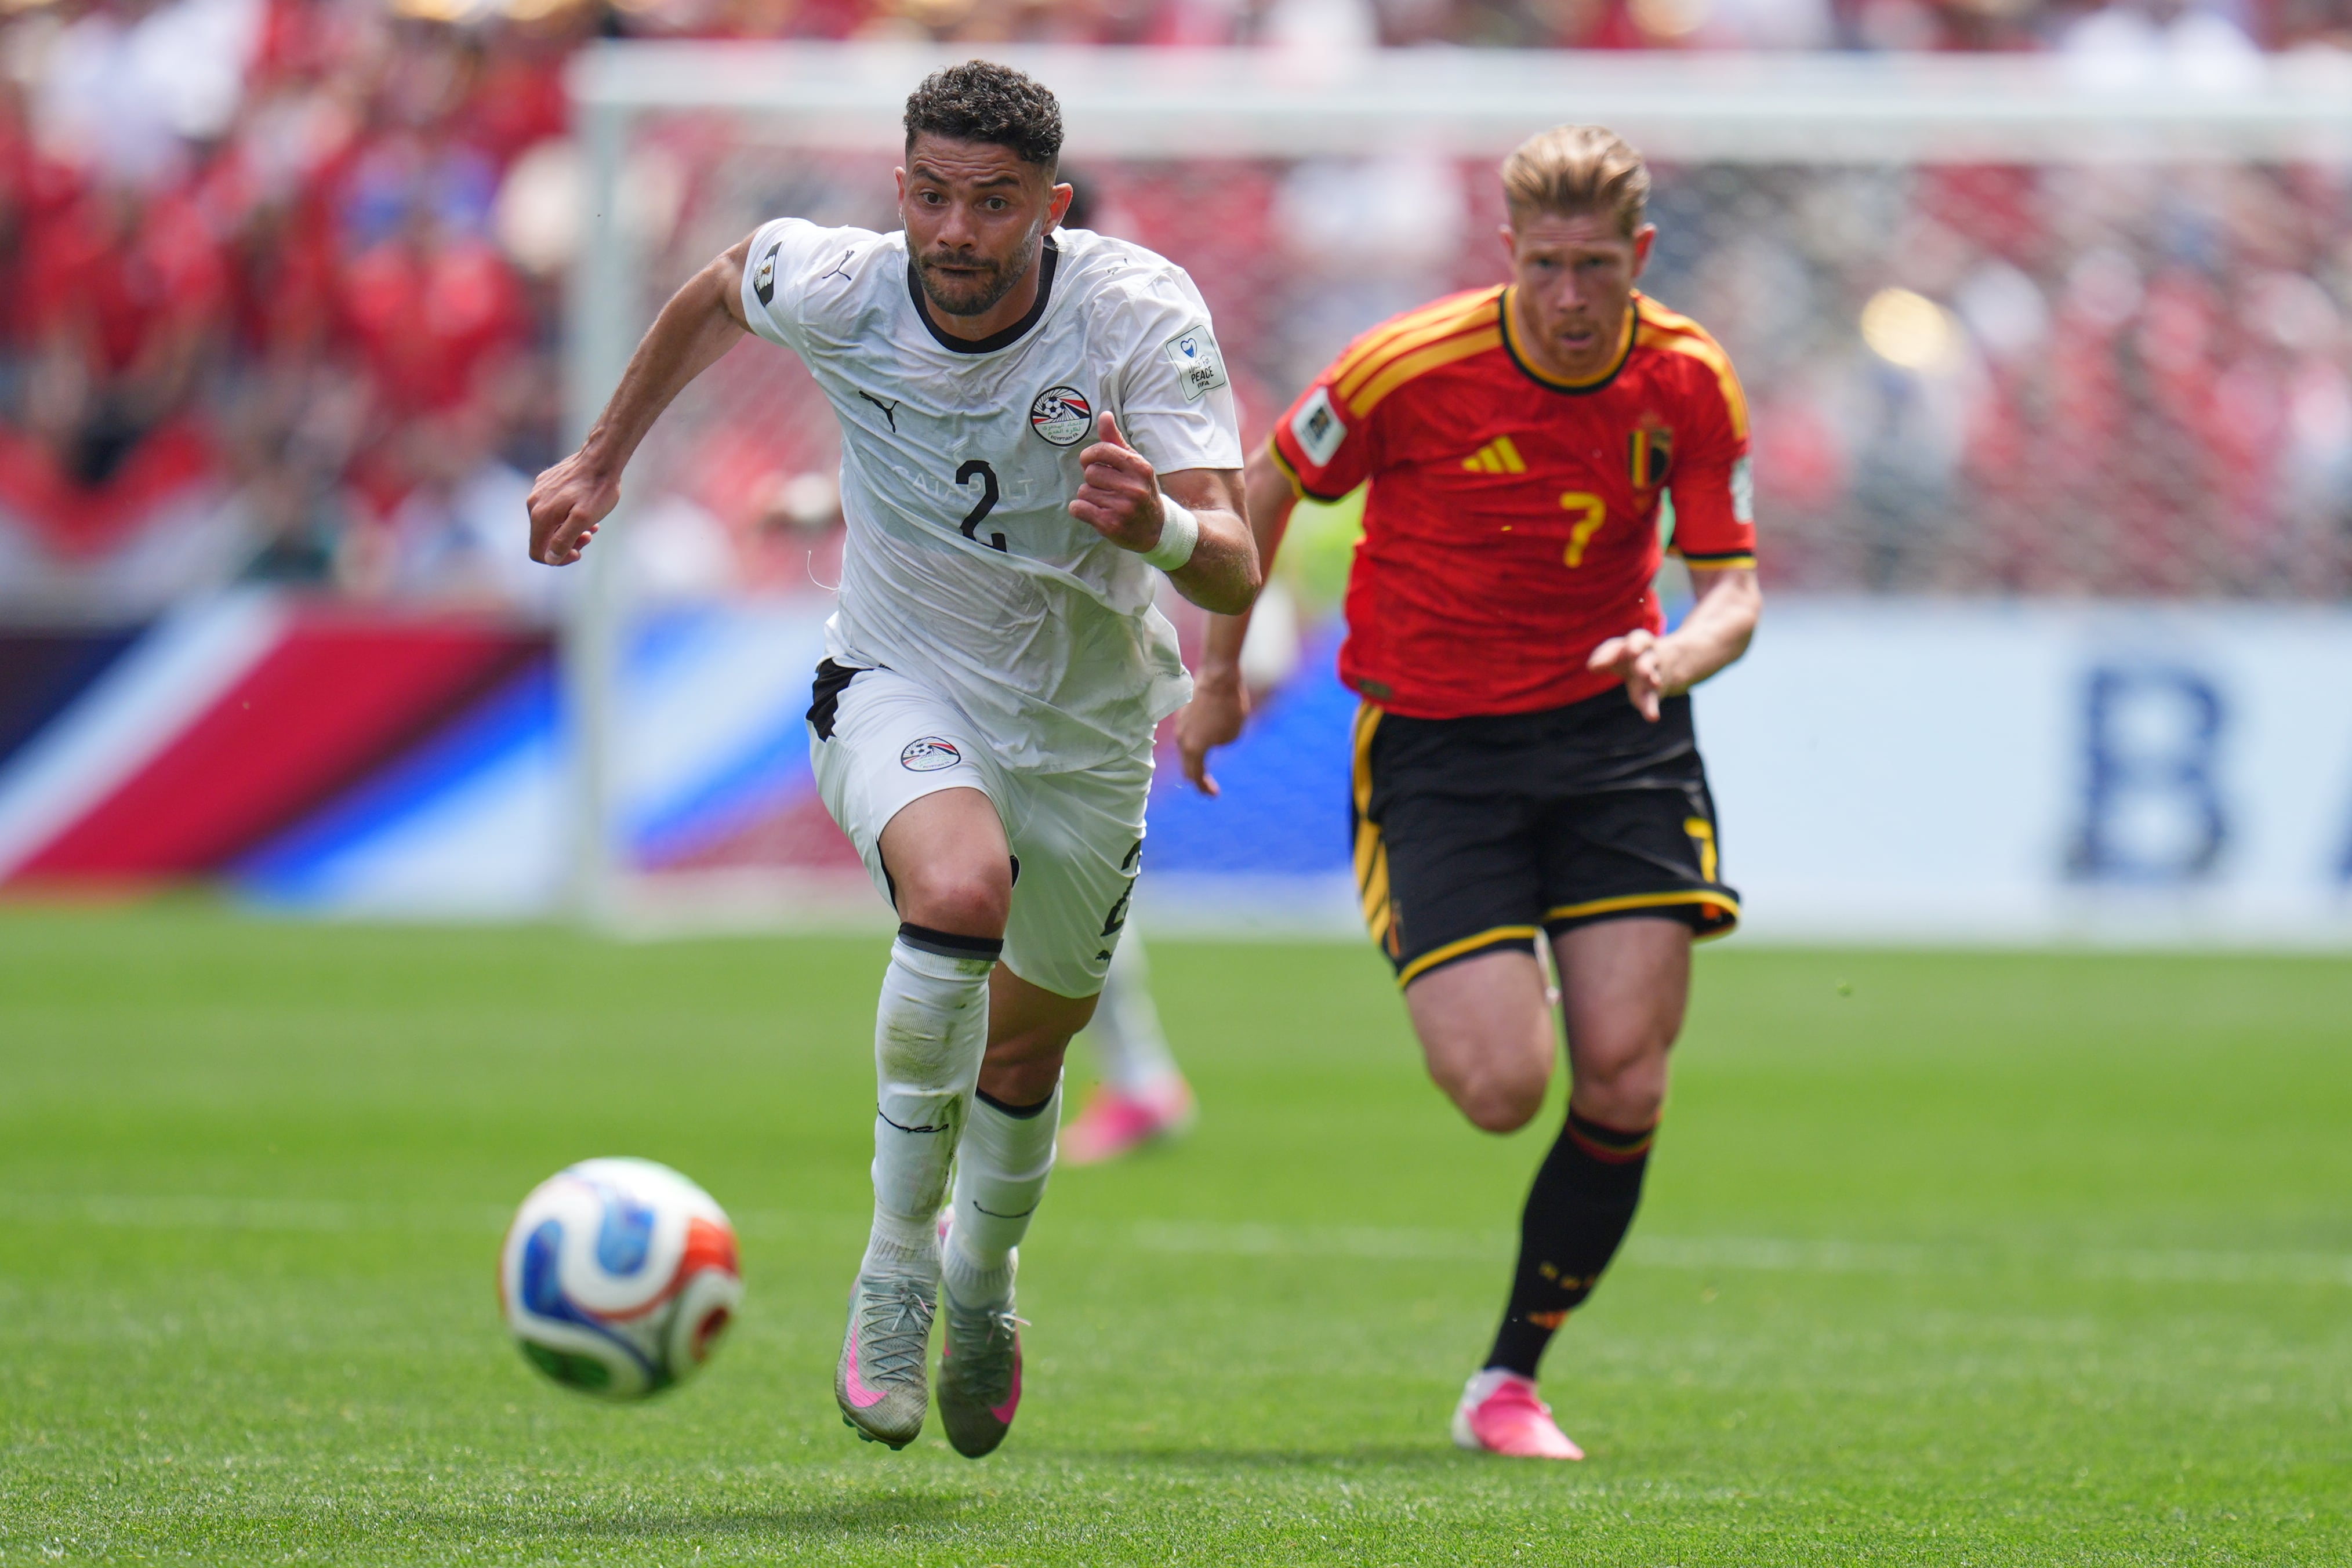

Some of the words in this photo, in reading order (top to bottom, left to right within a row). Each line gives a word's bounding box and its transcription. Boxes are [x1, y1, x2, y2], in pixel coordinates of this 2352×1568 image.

[1191, 366, 1214, 384] PEACE
[891, 465, 1035, 506] CATAPLT
[956, 460, 1007, 553] 2
[1559, 491, 1606, 568] 7
[1683, 816, 1718, 884] 7
